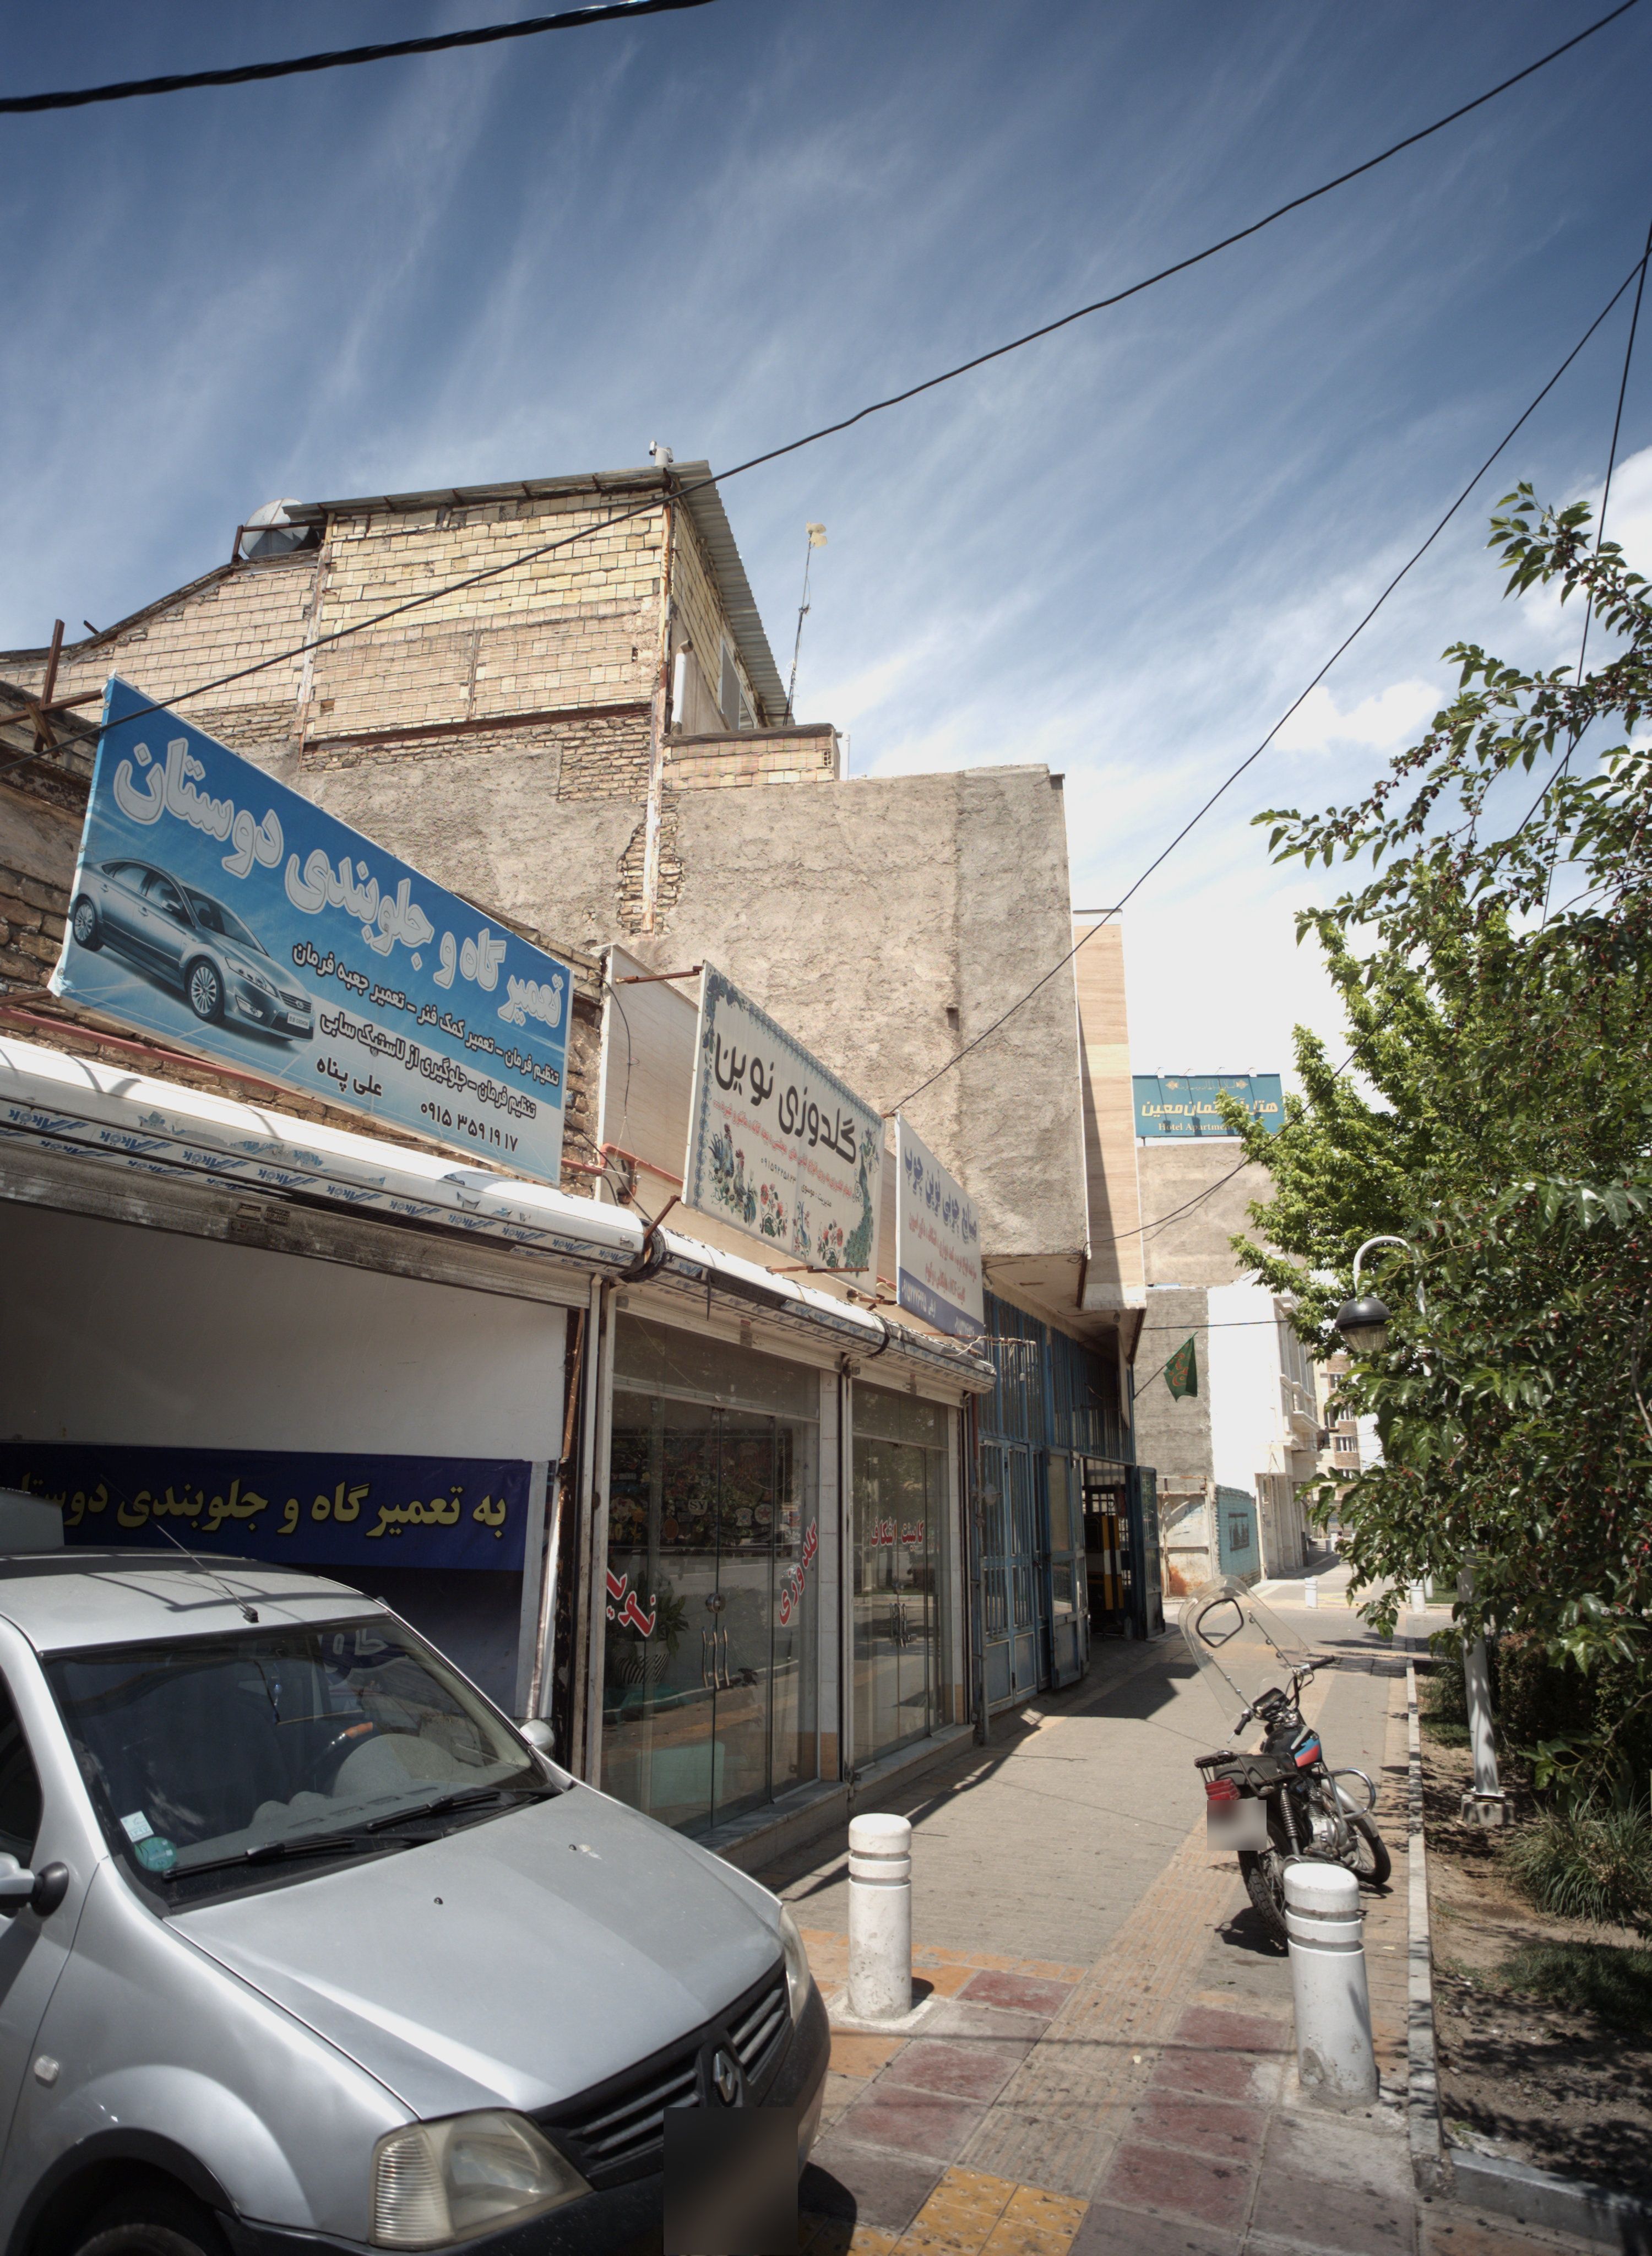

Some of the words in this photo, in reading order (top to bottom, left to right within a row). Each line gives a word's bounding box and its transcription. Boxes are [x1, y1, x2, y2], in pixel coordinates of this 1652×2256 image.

[114, 737, 284, 879] دوستان
[285, 849, 434, 971] جلوبندی
[292, 941, 335, 977] فرمان
[433, 931, 457, 989] و
[460, 929, 507, 991] گاه
[336, 962, 369, 996] جعبه
[369, 984, 406, 1010] تعمیر
[417, 1004, 438, 1026] فنر
[498, 974, 564, 1027] تعمیر
[357, 1024, 405, 1061] لاستیک
[439, 1013, 465, 1039] کمک
[465, 1032, 494, 1054] تعمیر
[317, 1057, 349, 1092] پناه
[405, 1044, 420, 1070] از
[420, 1058, 467, 1092] جلوگیری
[505, 1048, 532, 1075] فرمان
[532, 1064, 560, 1086] تنظیم
[715, 1033, 774, 1107] نوین
[353, 1075, 382, 1097] علی
[477, 1080, 508, 1109] فرمان
[421, 1102, 452, 1126] ۰۹۱۵
[457, 1114, 485, 1140] ۳۵۹
[508, 1096, 536, 1119] تنظیم
[778, 1086, 856, 1164] گلدوزی
[1141, 1101, 1183, 1118] معین
[904, 1146, 923, 1202] چوب
[943, 1192, 960, 1238] چوبی
[962, 1203, 977, 1244] صنایع
[116, 1478, 269, 1532] جلوبندی
[276, 1496, 300, 1534] و
[311, 1481, 371, 1522] گاه
[366, 1485, 464, 1538] تعمیر
[472, 1494, 507, 1538] به
[871, 1516, 898, 1547] اشکاف
[900, 1520, 924, 1552] کابینت
[779, 1516, 818, 1626] گلدوزی
[606, 1567, 656, 1638] نوی
